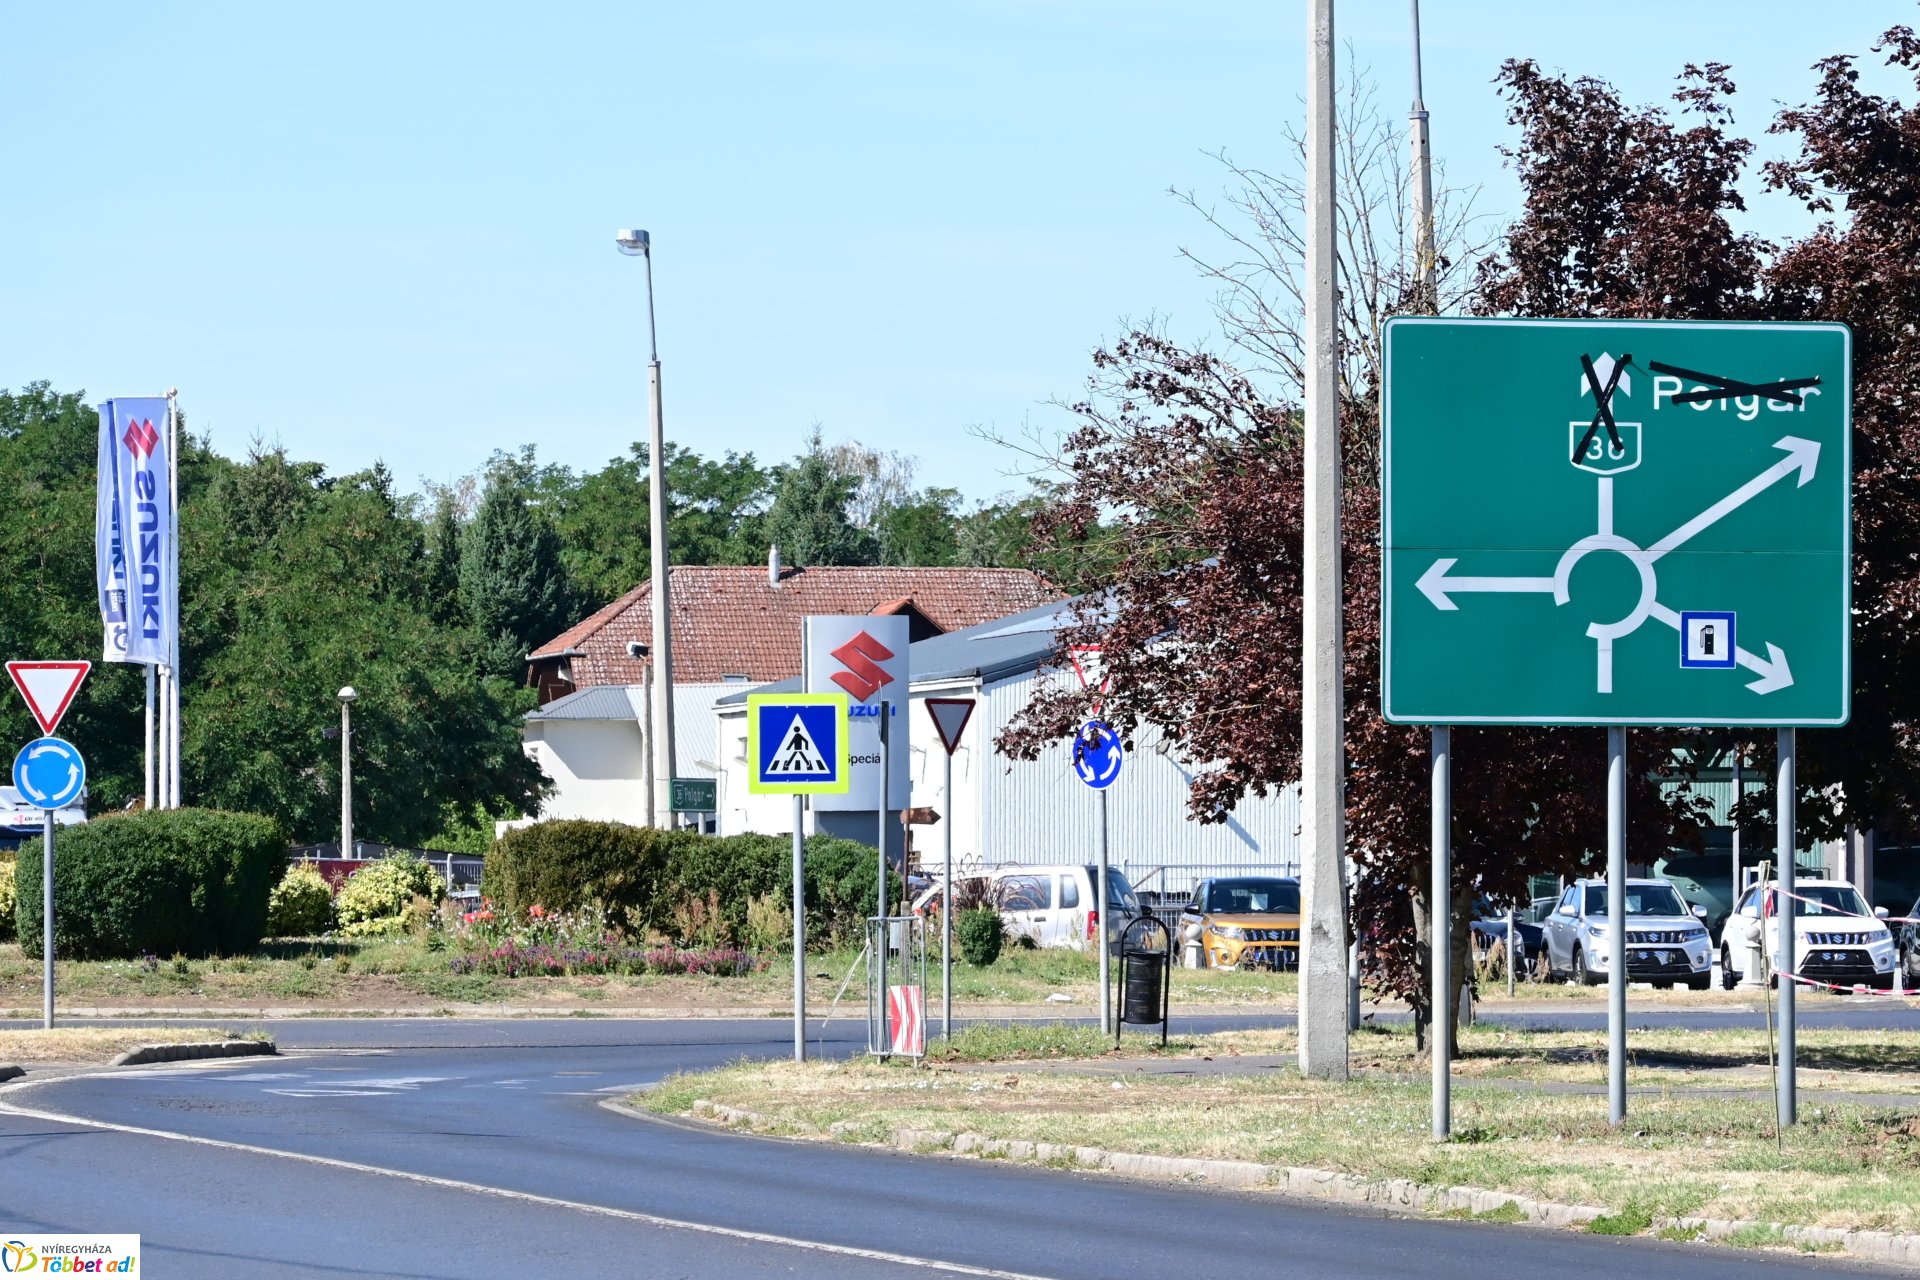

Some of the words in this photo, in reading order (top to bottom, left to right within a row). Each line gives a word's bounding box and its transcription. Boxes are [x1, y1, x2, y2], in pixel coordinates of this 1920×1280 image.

[1586, 435, 1625, 460] 36
[848, 705, 896, 717] UZUI
[848, 753, 880, 766] peciá
